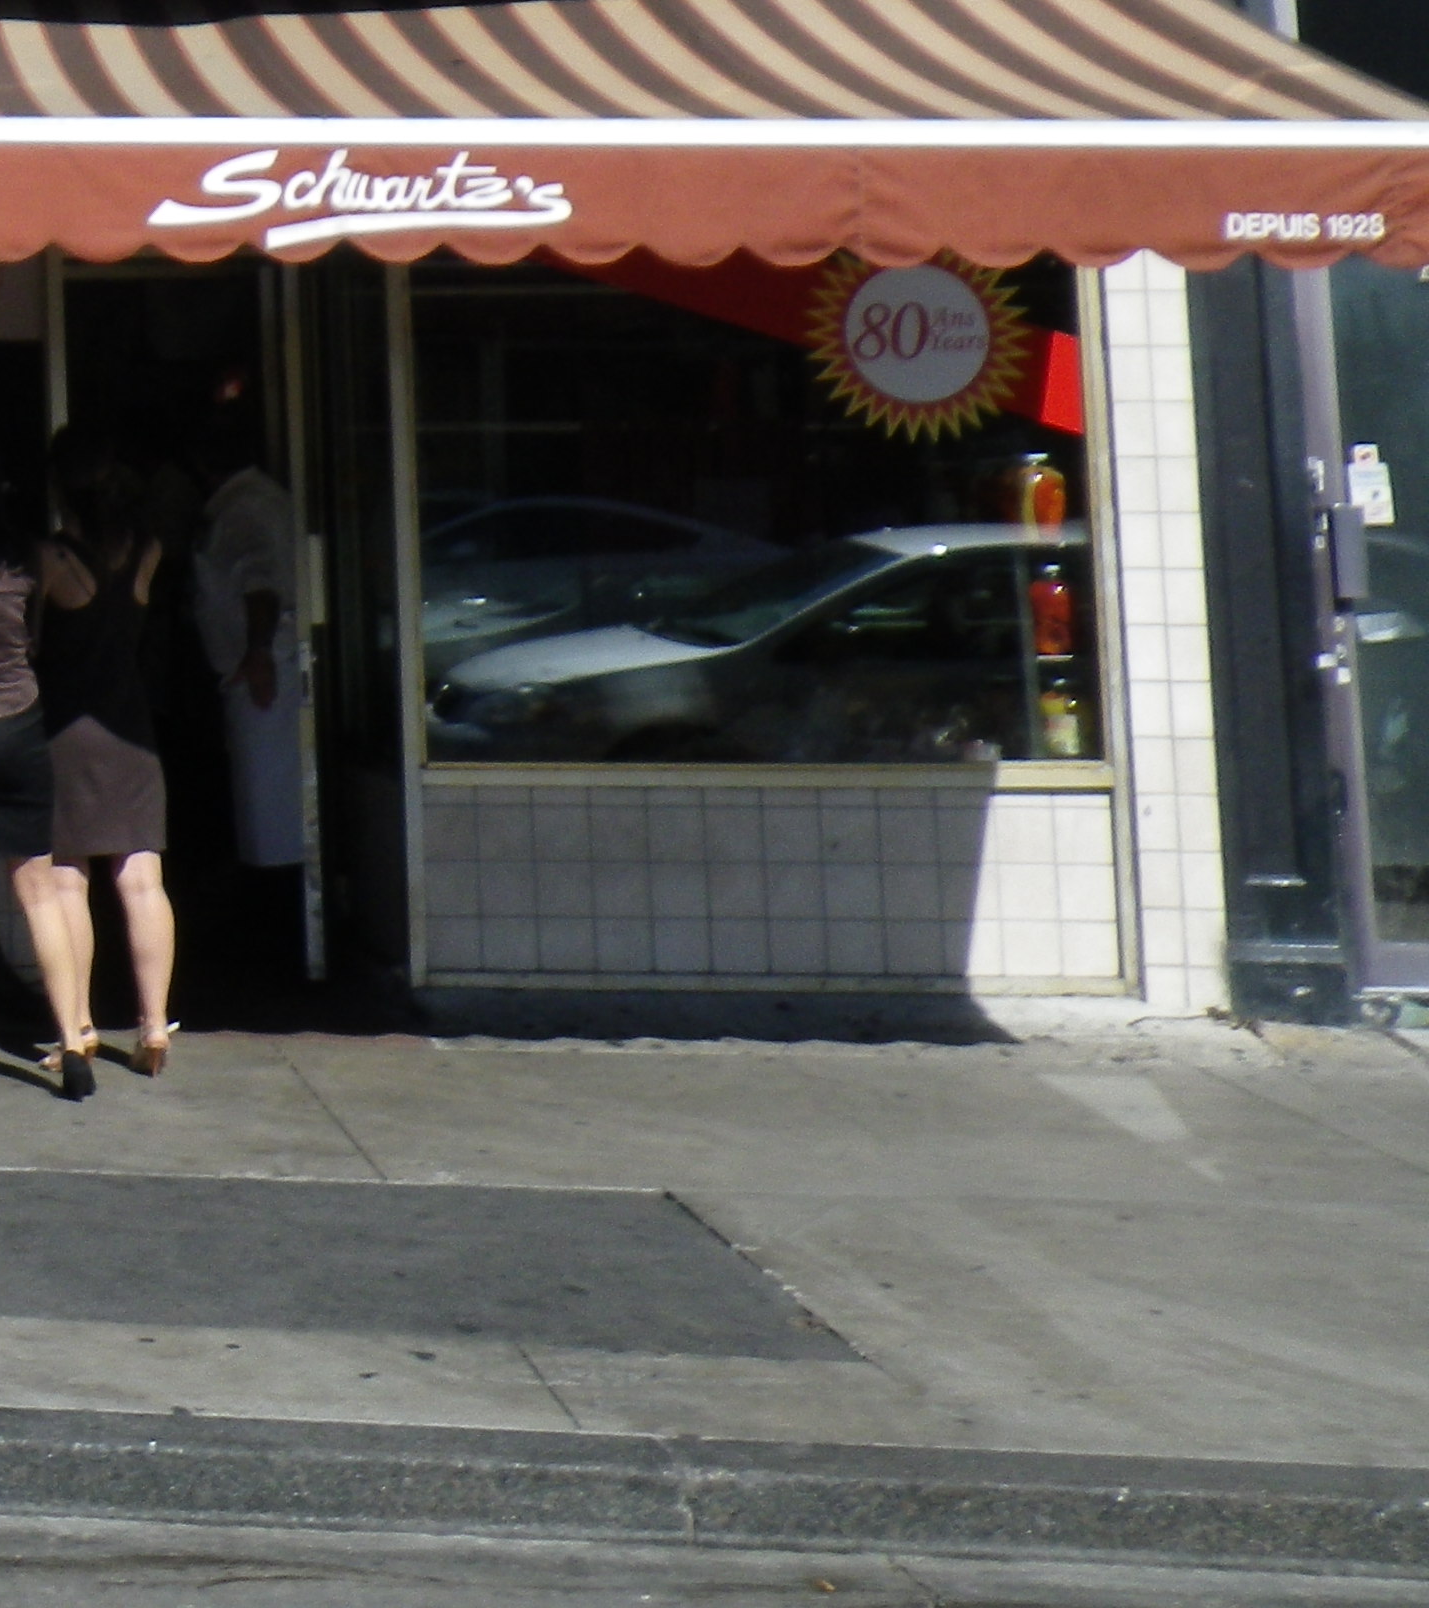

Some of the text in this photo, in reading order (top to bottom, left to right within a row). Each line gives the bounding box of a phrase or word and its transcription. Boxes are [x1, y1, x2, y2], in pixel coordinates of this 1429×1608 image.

[147, 148, 572, 249] Schwartz's
[1226, 212, 1385, 240] DEPUIS 1928
[853, 301, 928, 360] 80
